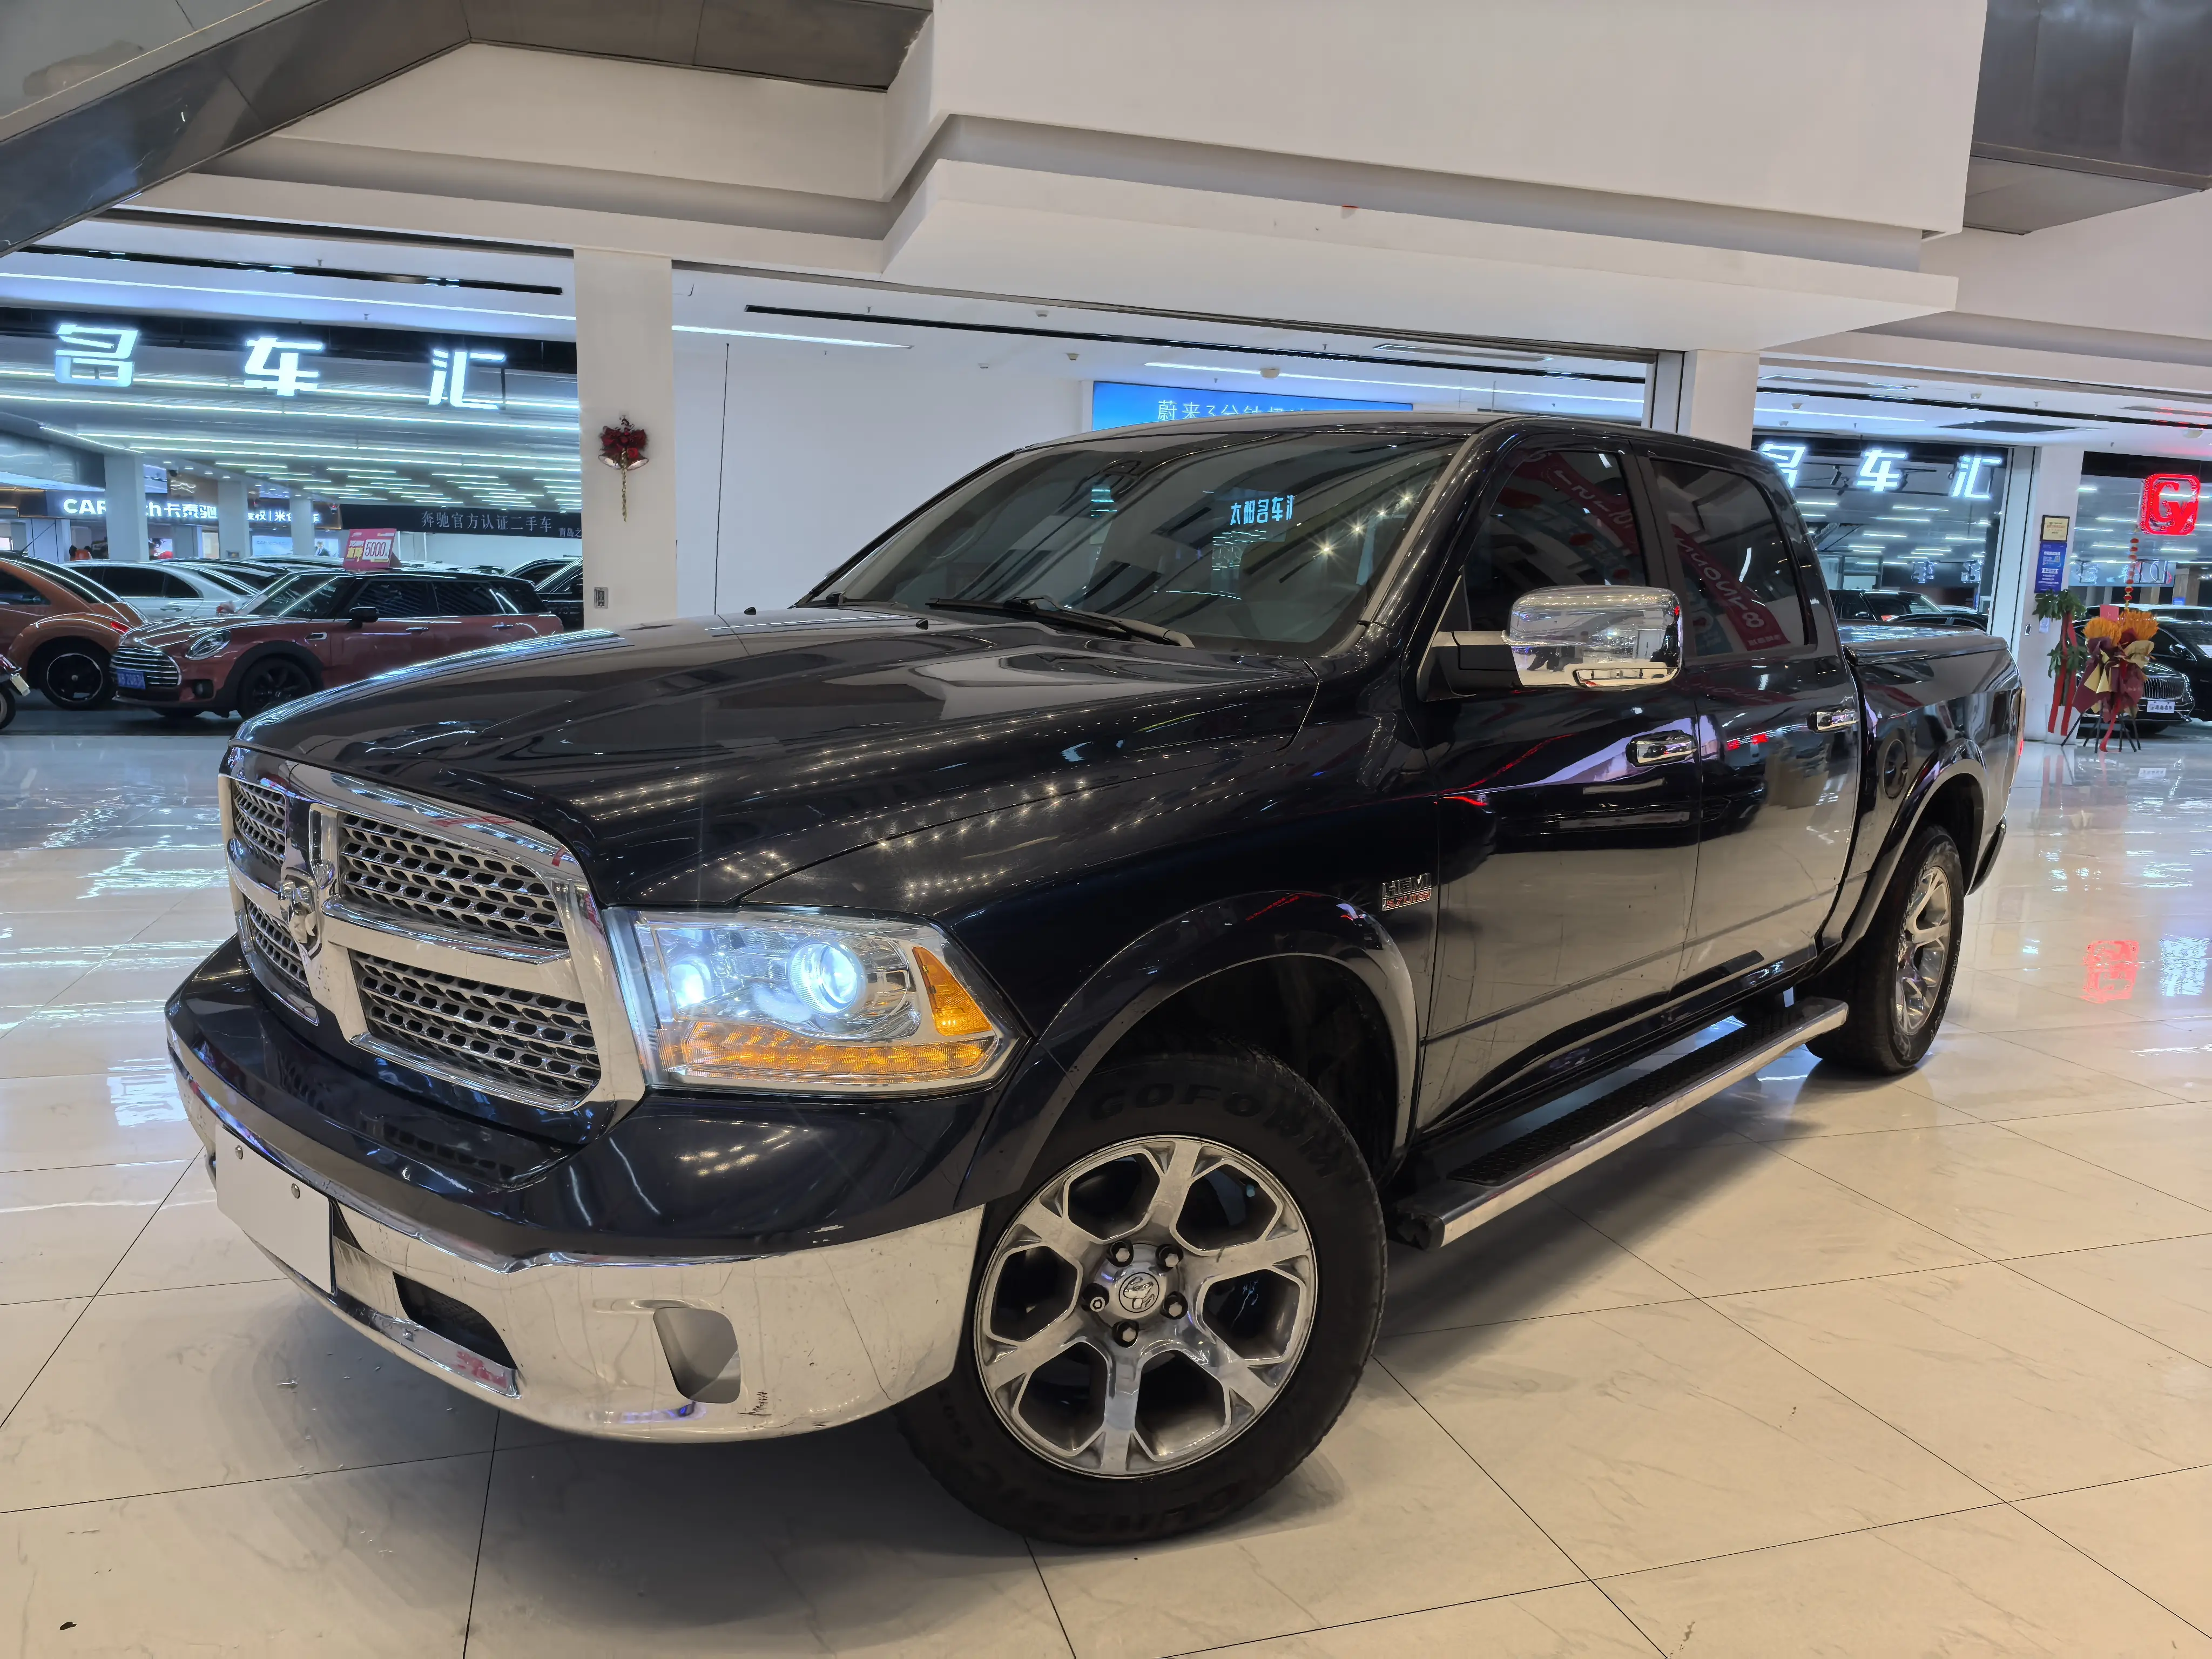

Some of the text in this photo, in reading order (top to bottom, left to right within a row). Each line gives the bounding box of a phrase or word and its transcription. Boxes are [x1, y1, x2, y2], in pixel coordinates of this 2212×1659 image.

[55, 323, 506, 410] 名车汇
[421, 510, 552, 532] 奔驰官方认证二手车
[1382, 873, 1432, 899] HEMI
[1386, 890, 1431, 909] 5.7 LITER
